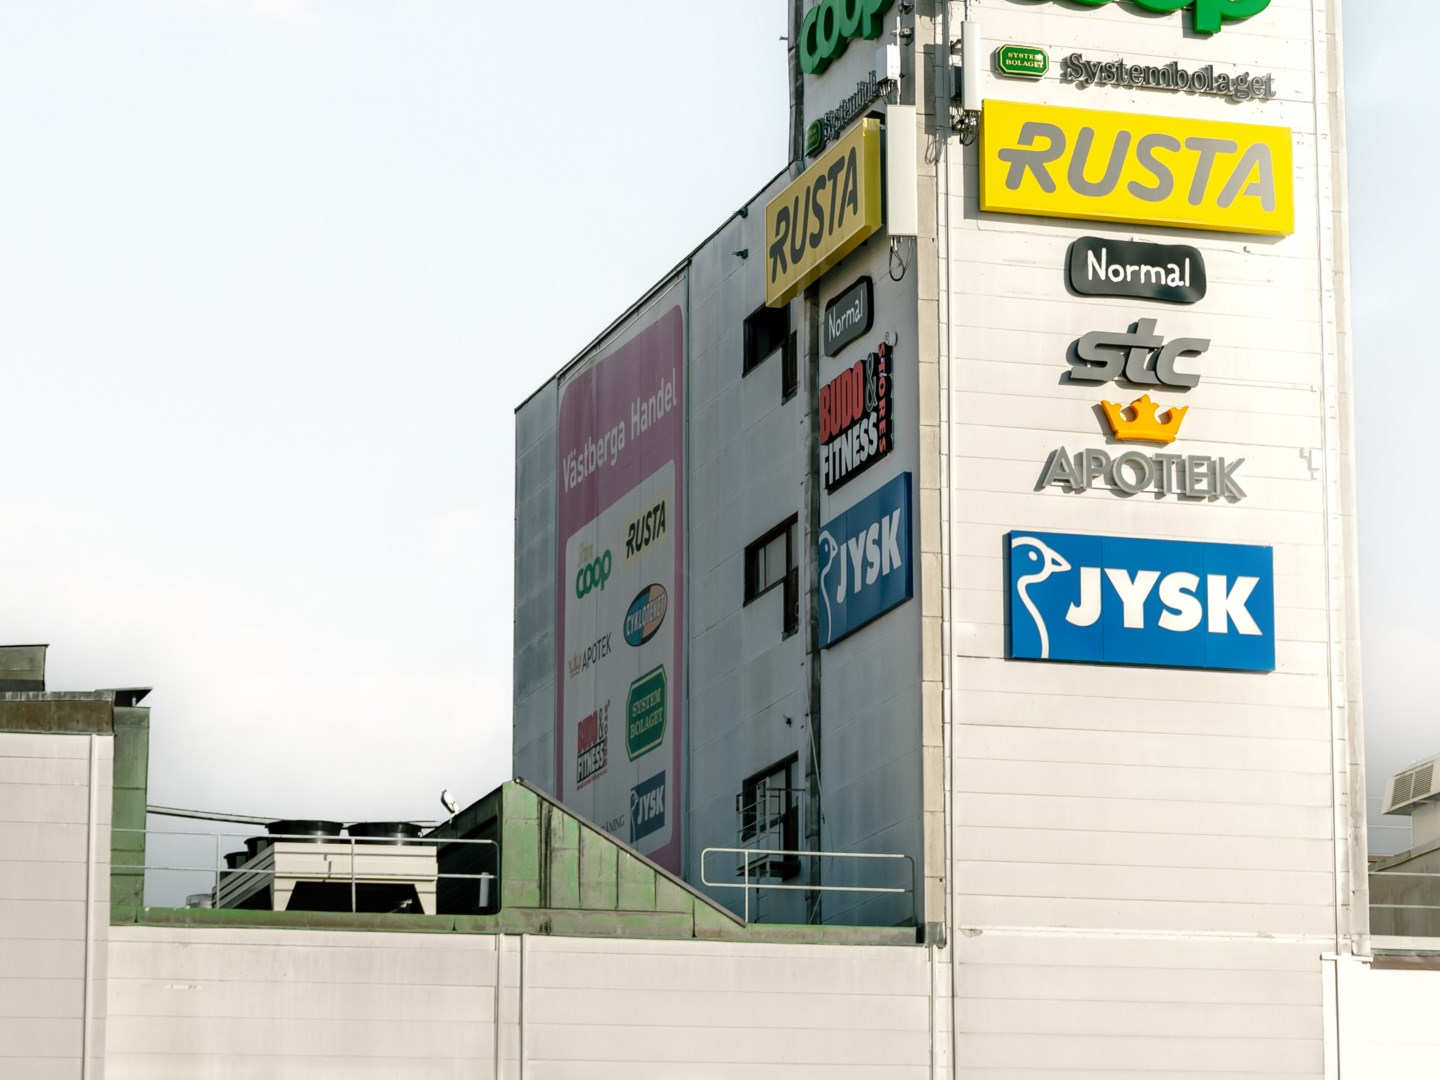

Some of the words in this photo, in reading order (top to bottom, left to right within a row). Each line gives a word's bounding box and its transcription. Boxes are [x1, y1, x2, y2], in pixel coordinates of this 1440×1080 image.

[1006, 59, 1044, 69] BOLAGET
[1067, 53, 1276, 99] Systembolaget
[998, 121, 1276, 212] RUSTA
[769, 146, 859, 284] RUSTA
[1087, 248, 1190, 287] Normal
[828, 289, 863, 342] Normal
[1070, 317, 1211, 388] stc
[820, 360, 864, 445] BUDO
[878, 342, 887, 453] STORES
[562, 420, 625, 493] Västberga
[630, 368, 677, 441] Handel
[820, 411, 879, 489] FITNESS
[1043, 446, 1247, 499] APOTEK
[625, 500, 666, 559] RUSTA
[836, 507, 902, 604] JYSK
[576, 549, 612, 600] coop
[1065, 567, 1263, 635] JYSK
[581, 632, 612, 673] APOTEK
[629, 706, 664, 739] BOLAGET
[631, 686, 662, 717] SYSTEM
[577, 743, 604, 781] FITNESS
[636, 784, 664, 826] JYSK
